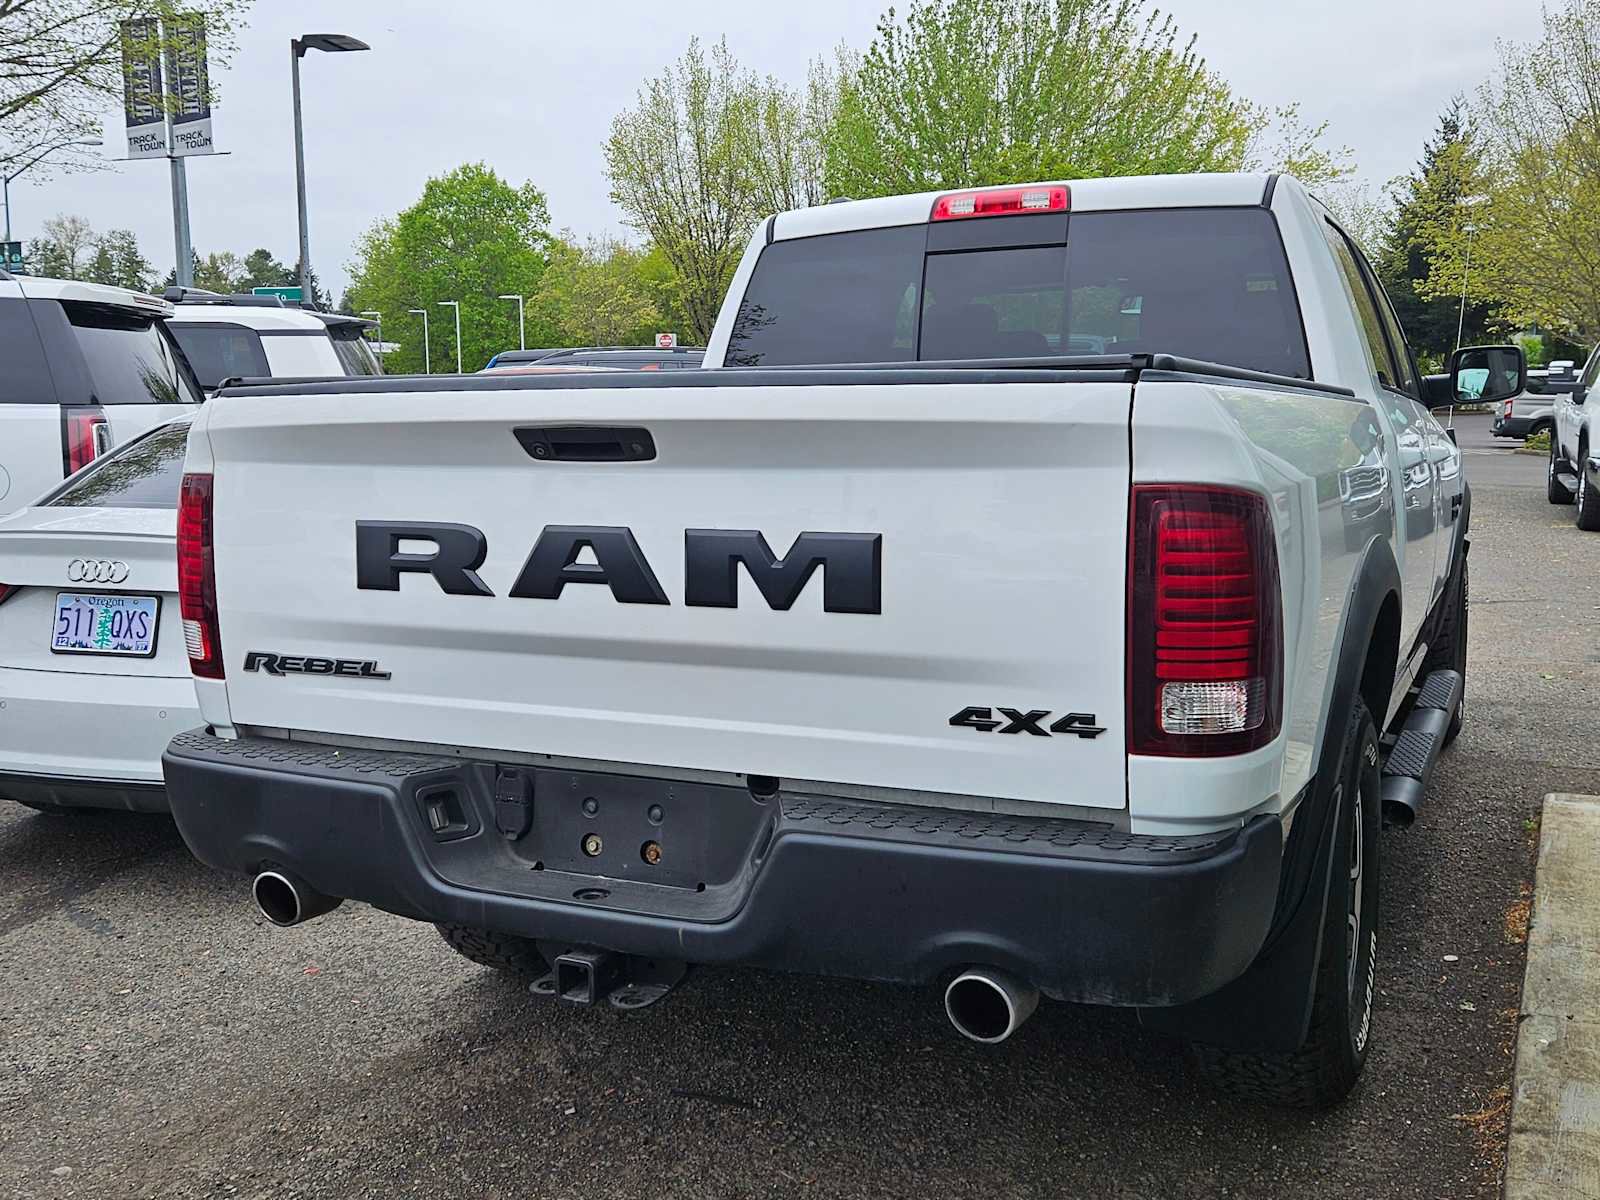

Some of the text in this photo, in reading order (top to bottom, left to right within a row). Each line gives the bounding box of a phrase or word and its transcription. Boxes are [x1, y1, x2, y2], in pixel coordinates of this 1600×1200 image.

[128, 133, 157, 145] TRACK
[175, 130, 203, 143] TRACK
[186, 137, 212, 149] TOWN
[139, 140, 165, 152] TOWN
[356, 519, 882, 615] RAM
[88, 596, 124, 608] Oregon
[58, 607, 149, 639] 511 QXS
[243, 651, 391, 680] REBEL
[949, 706, 1107, 739] 4X4
